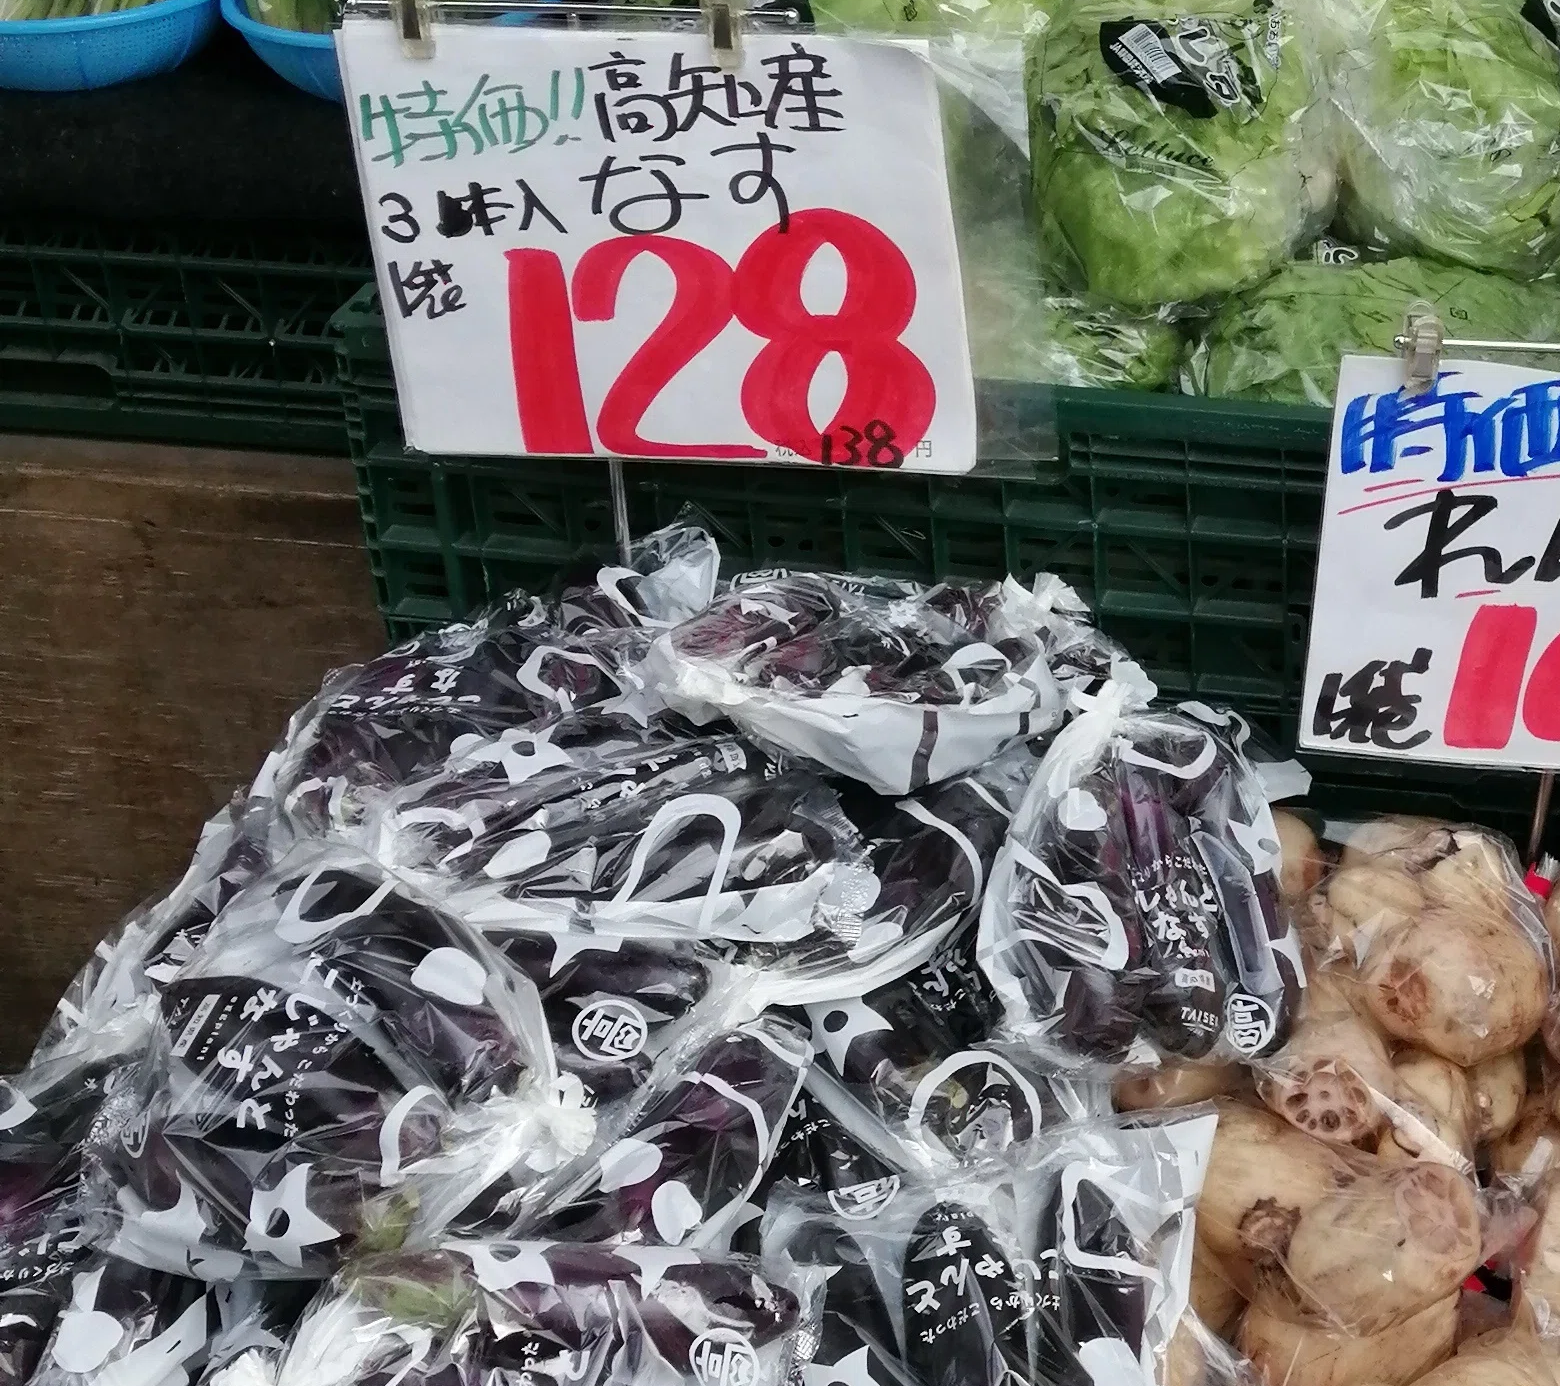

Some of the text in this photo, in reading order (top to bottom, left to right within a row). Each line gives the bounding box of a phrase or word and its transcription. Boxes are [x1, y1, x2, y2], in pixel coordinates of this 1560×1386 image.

[588, 41, 848, 143] 高知産
[578, 131, 797, 236] なす
[504, 207, 938, 465] 128
[819, 418, 905, 468] 138
[1151, 910, 1210, 942] なす
[217, 986, 279, 1085] なす
